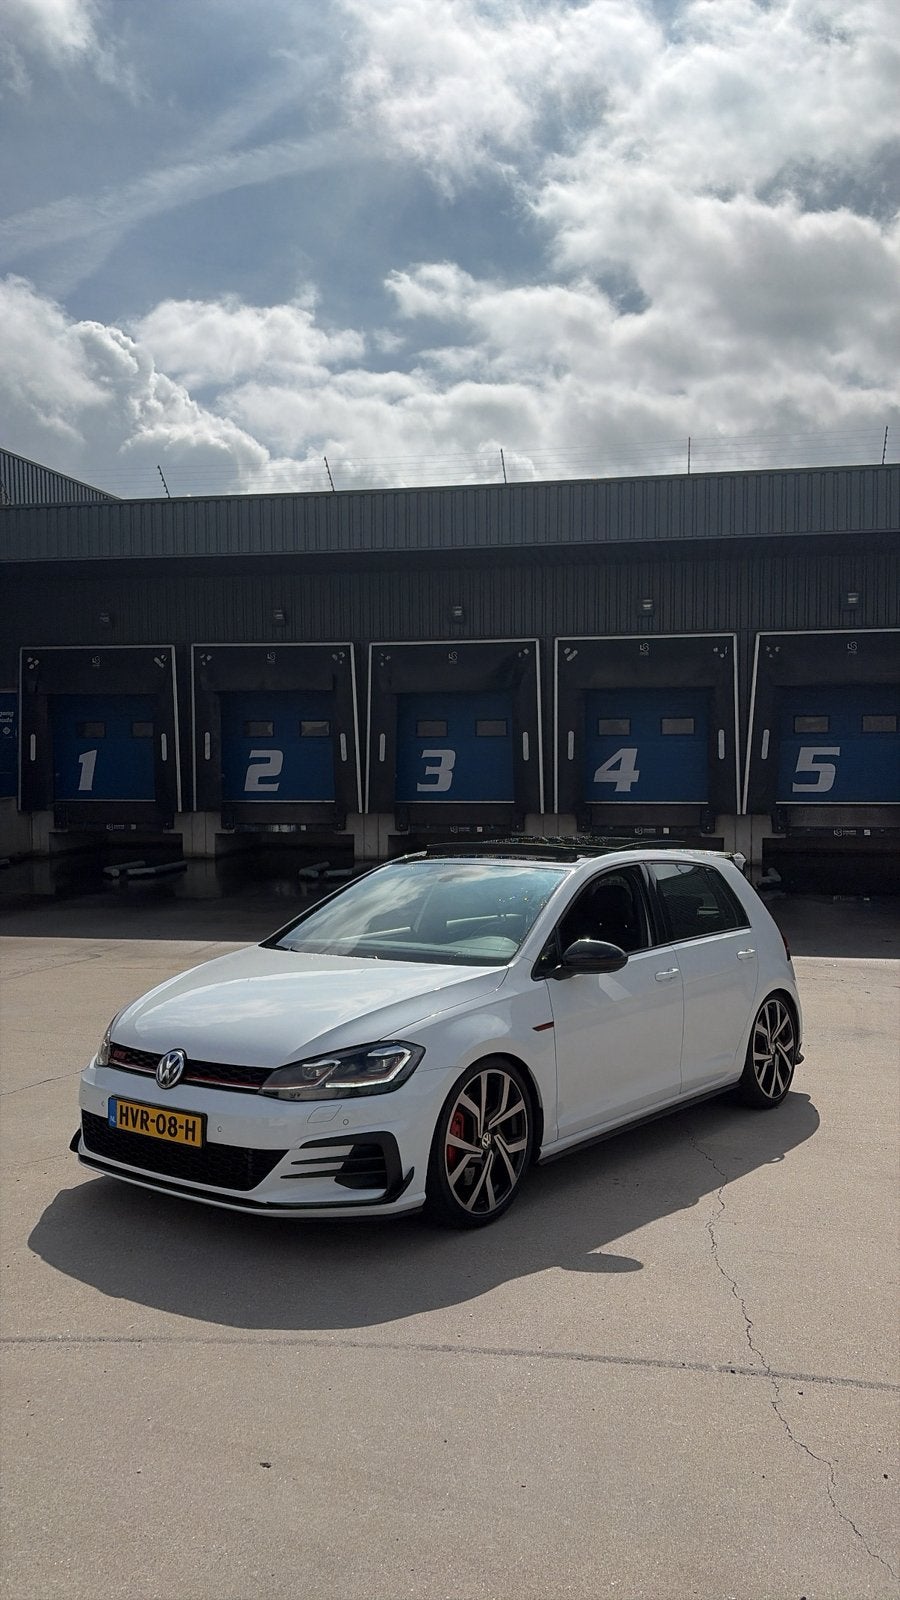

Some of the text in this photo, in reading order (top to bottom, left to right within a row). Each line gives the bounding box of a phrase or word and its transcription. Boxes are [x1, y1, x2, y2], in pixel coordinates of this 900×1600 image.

[78, 749, 97, 791] 1
[244, 749, 284, 792] 2
[416, 749, 456, 792] 3
[593, 747, 640, 792] 4
[792, 746, 841, 793] 5
[119, 1105, 197, 1142] HVR-08-H
